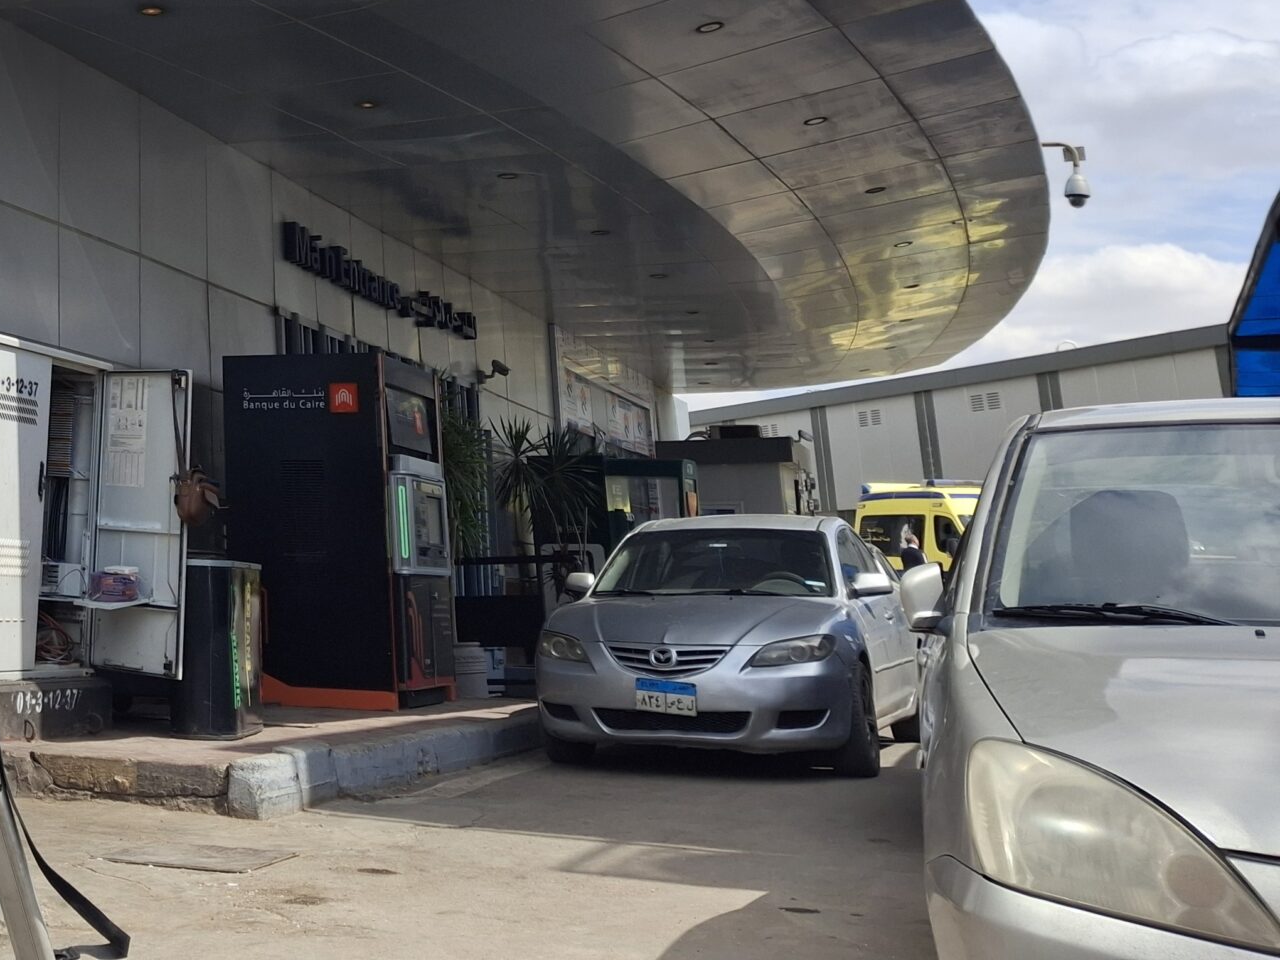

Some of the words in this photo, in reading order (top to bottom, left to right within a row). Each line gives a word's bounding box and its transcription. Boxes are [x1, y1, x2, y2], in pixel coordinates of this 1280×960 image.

[242, 400, 280, 411] Banque
[283, 400, 296, 409] du
[299, 400, 325, 409] Caire
